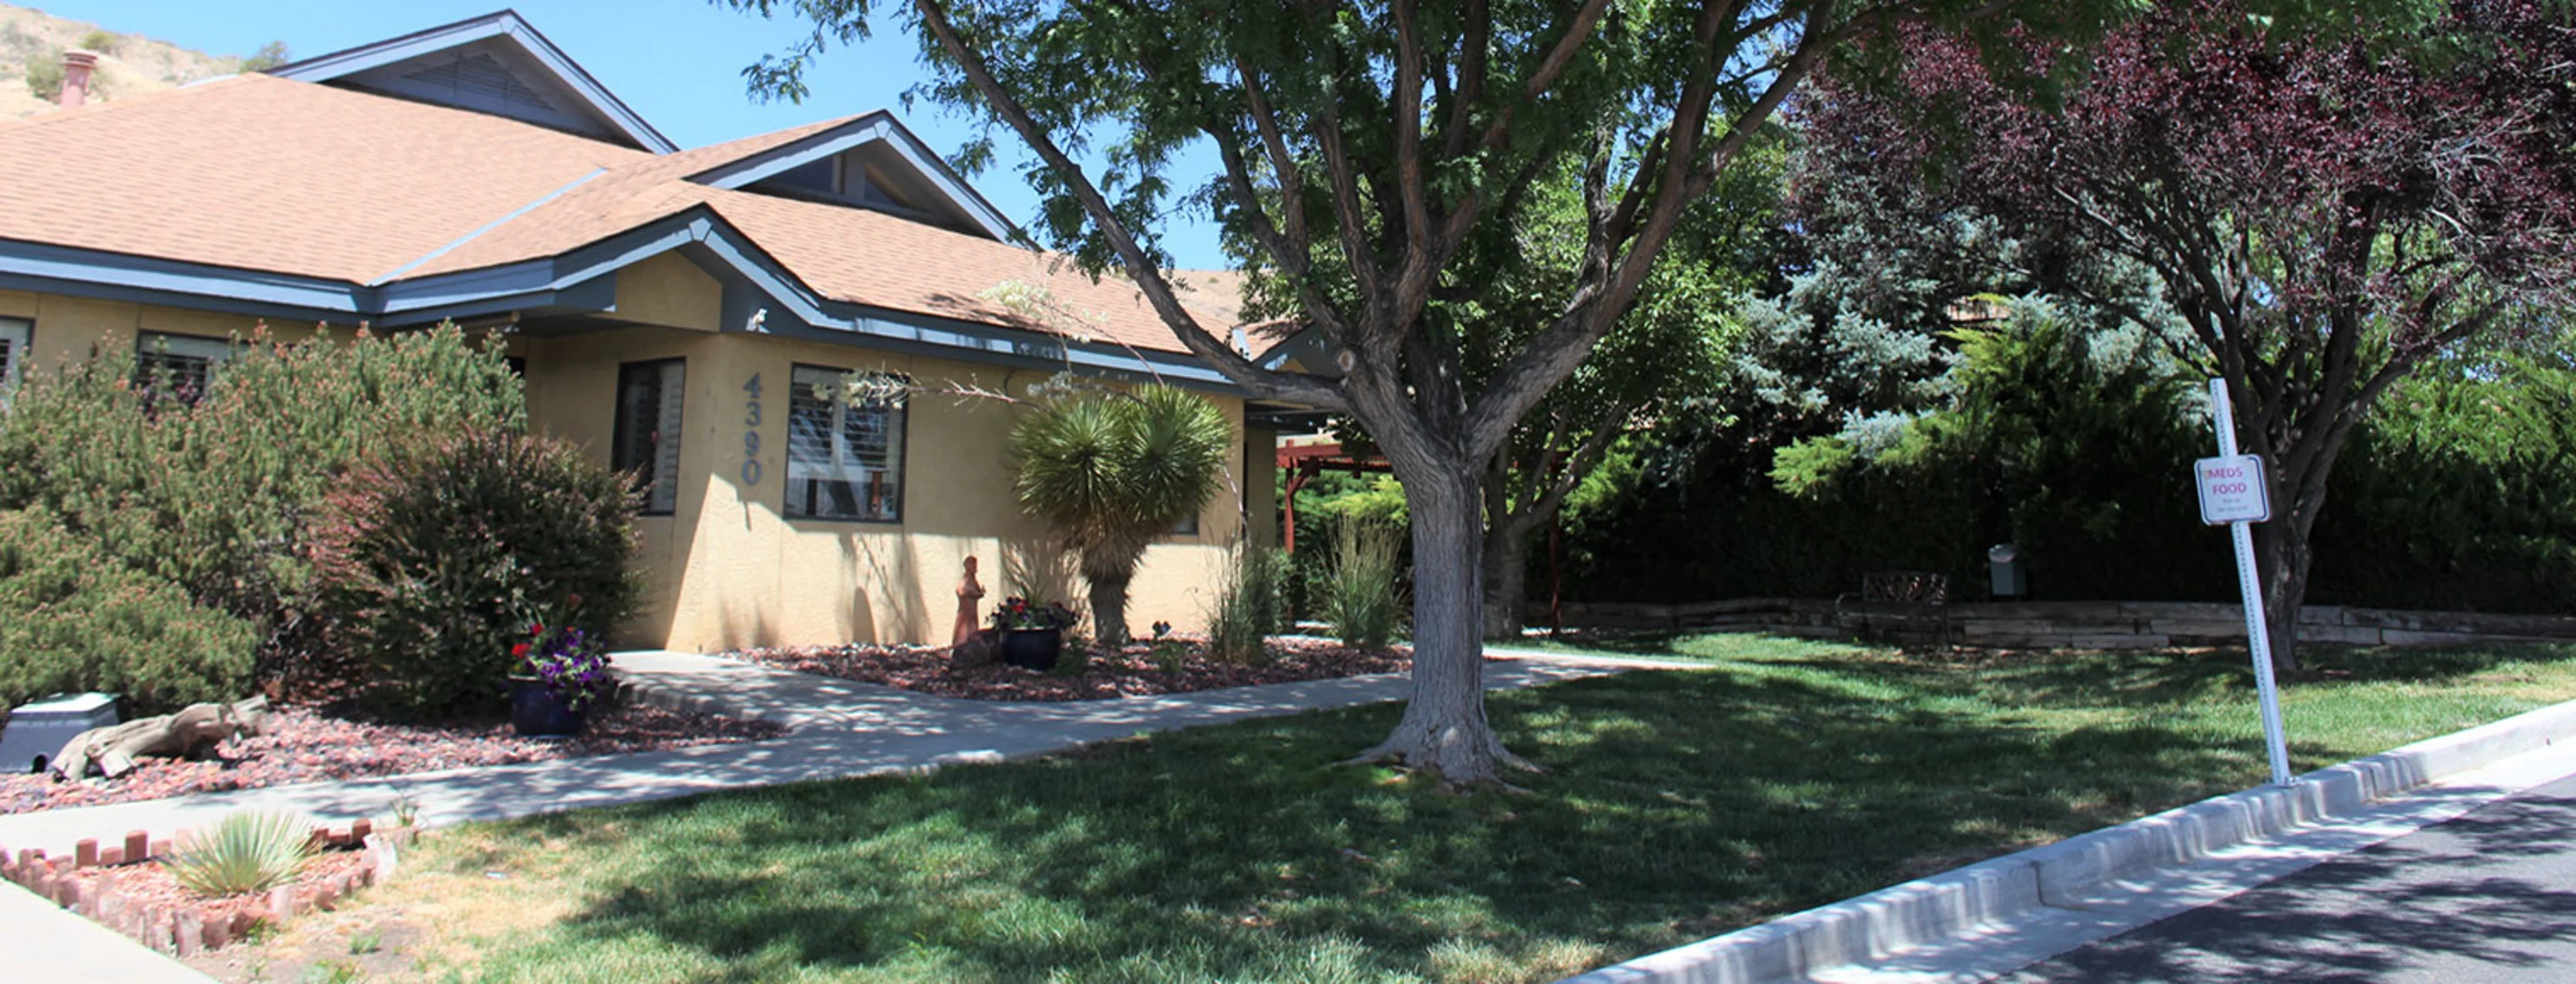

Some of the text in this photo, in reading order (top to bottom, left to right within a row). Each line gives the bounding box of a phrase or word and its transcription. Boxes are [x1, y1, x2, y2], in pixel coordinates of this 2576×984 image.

[742, 371, 763, 486] 4390
[2209, 467, 2243, 479] MEDS
[2212, 482, 2247, 495] FOOD
